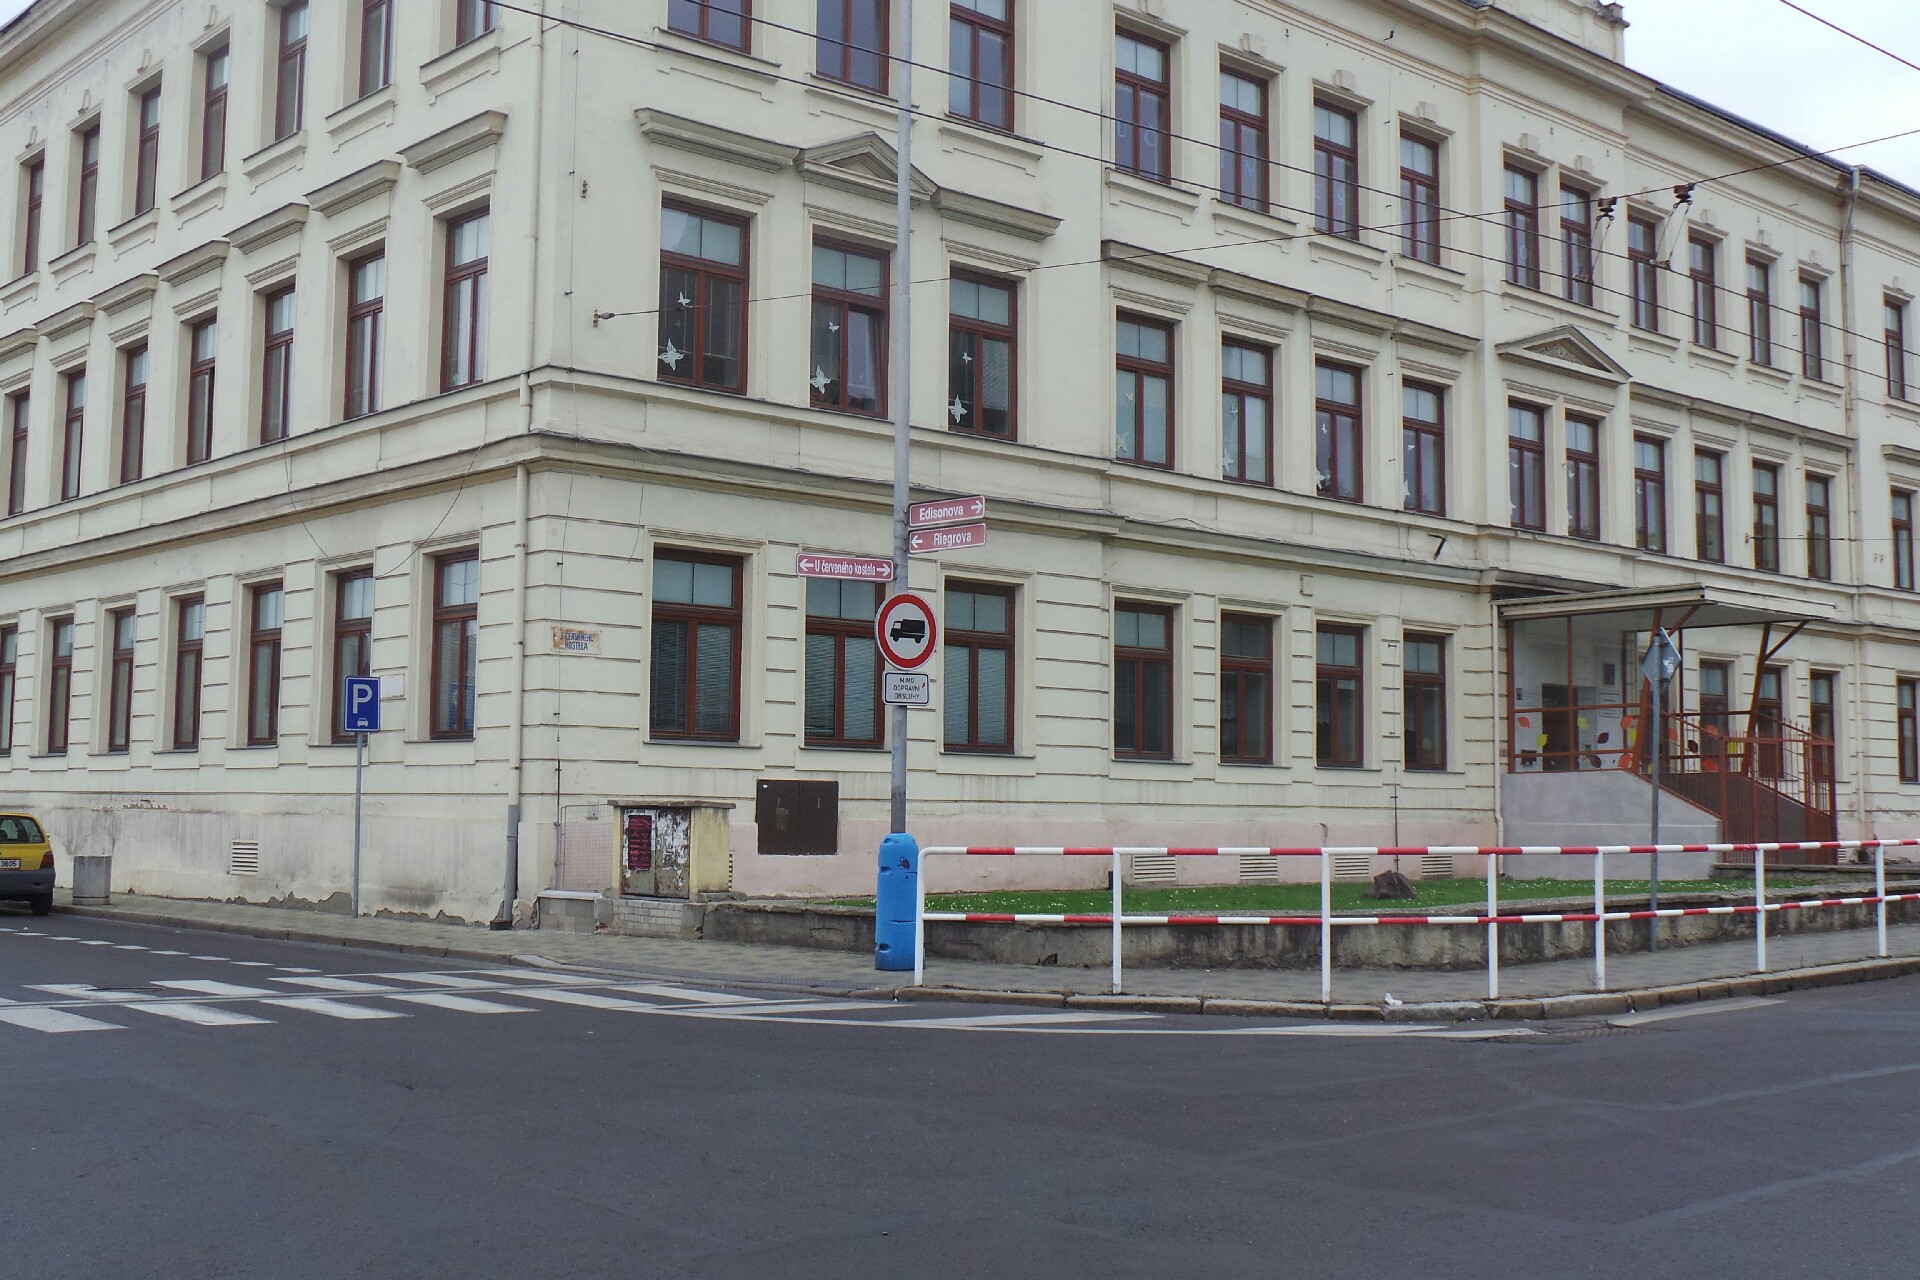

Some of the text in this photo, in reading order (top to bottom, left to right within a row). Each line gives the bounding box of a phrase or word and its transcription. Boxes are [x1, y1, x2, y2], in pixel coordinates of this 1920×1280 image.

[919, 505, 964, 521] Edisonova
[933, 532, 972, 547] Riegrova
[814, 559, 876, 576] U červeného kostela
[352, 683, 373, 714] P
